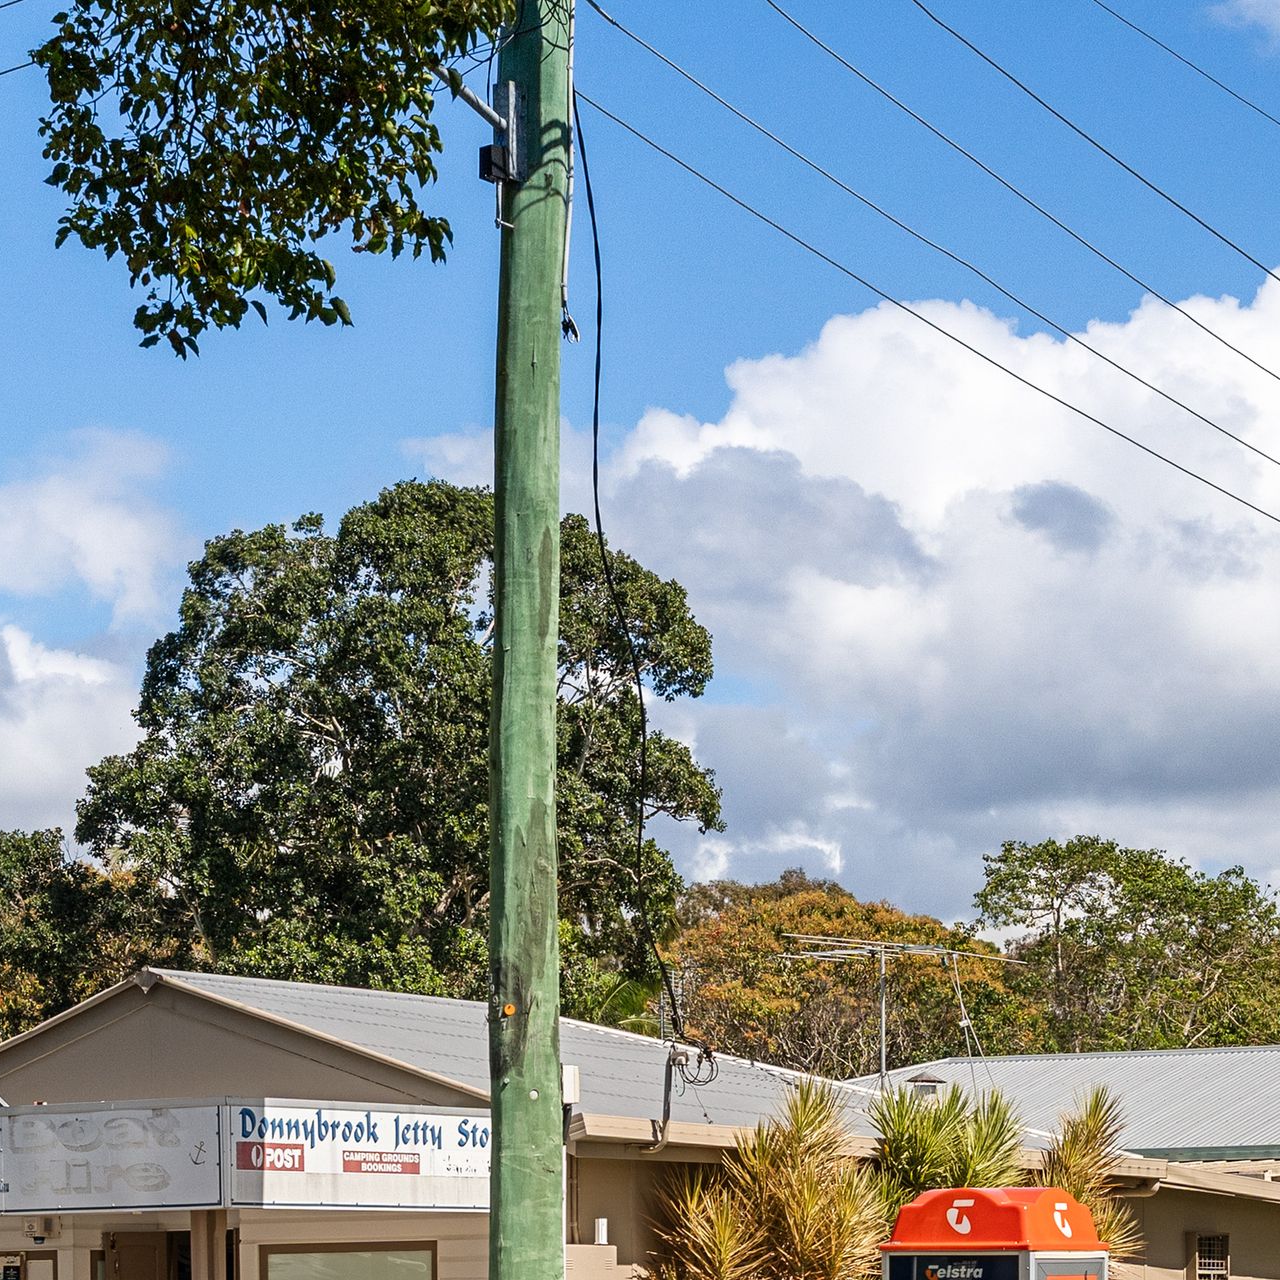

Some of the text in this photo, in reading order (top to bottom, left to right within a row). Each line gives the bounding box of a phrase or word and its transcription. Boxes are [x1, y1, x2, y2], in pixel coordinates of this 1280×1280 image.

[238, 1107, 490, 1150] Donnybrook Jetty Sto
[265, 1147, 302, 1169] POST
[343, 1151, 419, 1163] CAMPING GROUNDS
[361, 1162, 402, 1172] BOOKINGS
